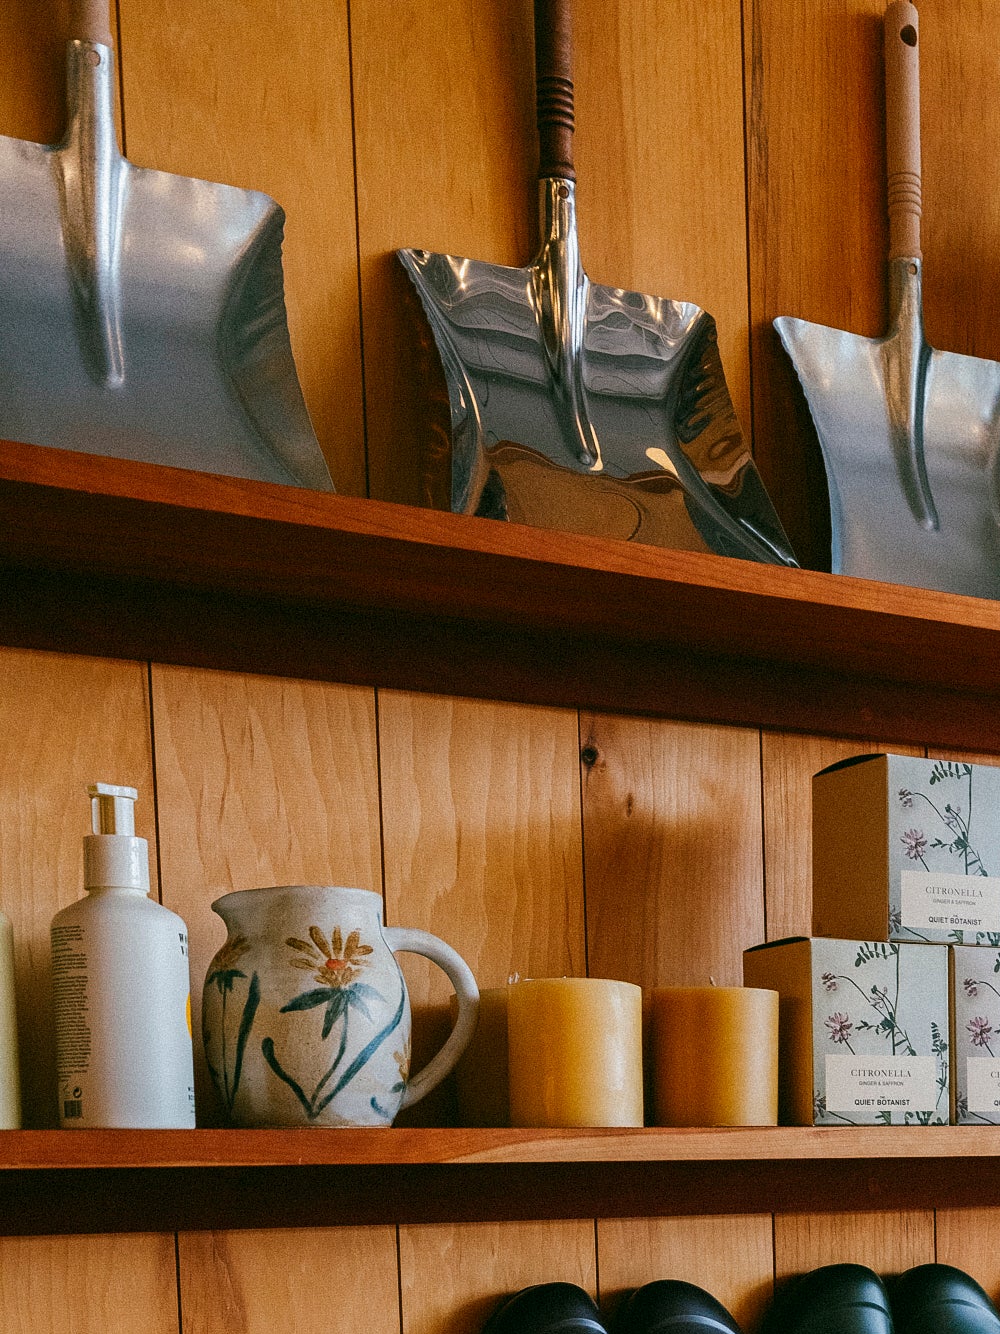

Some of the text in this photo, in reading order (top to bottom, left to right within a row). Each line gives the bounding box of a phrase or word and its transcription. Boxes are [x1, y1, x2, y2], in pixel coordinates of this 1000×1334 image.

[925, 886, 983, 898] CITRONELLA
[928, 915, 982, 926] QUIET BOTANIST
[850, 1069, 912, 1078] CITRONELLA
